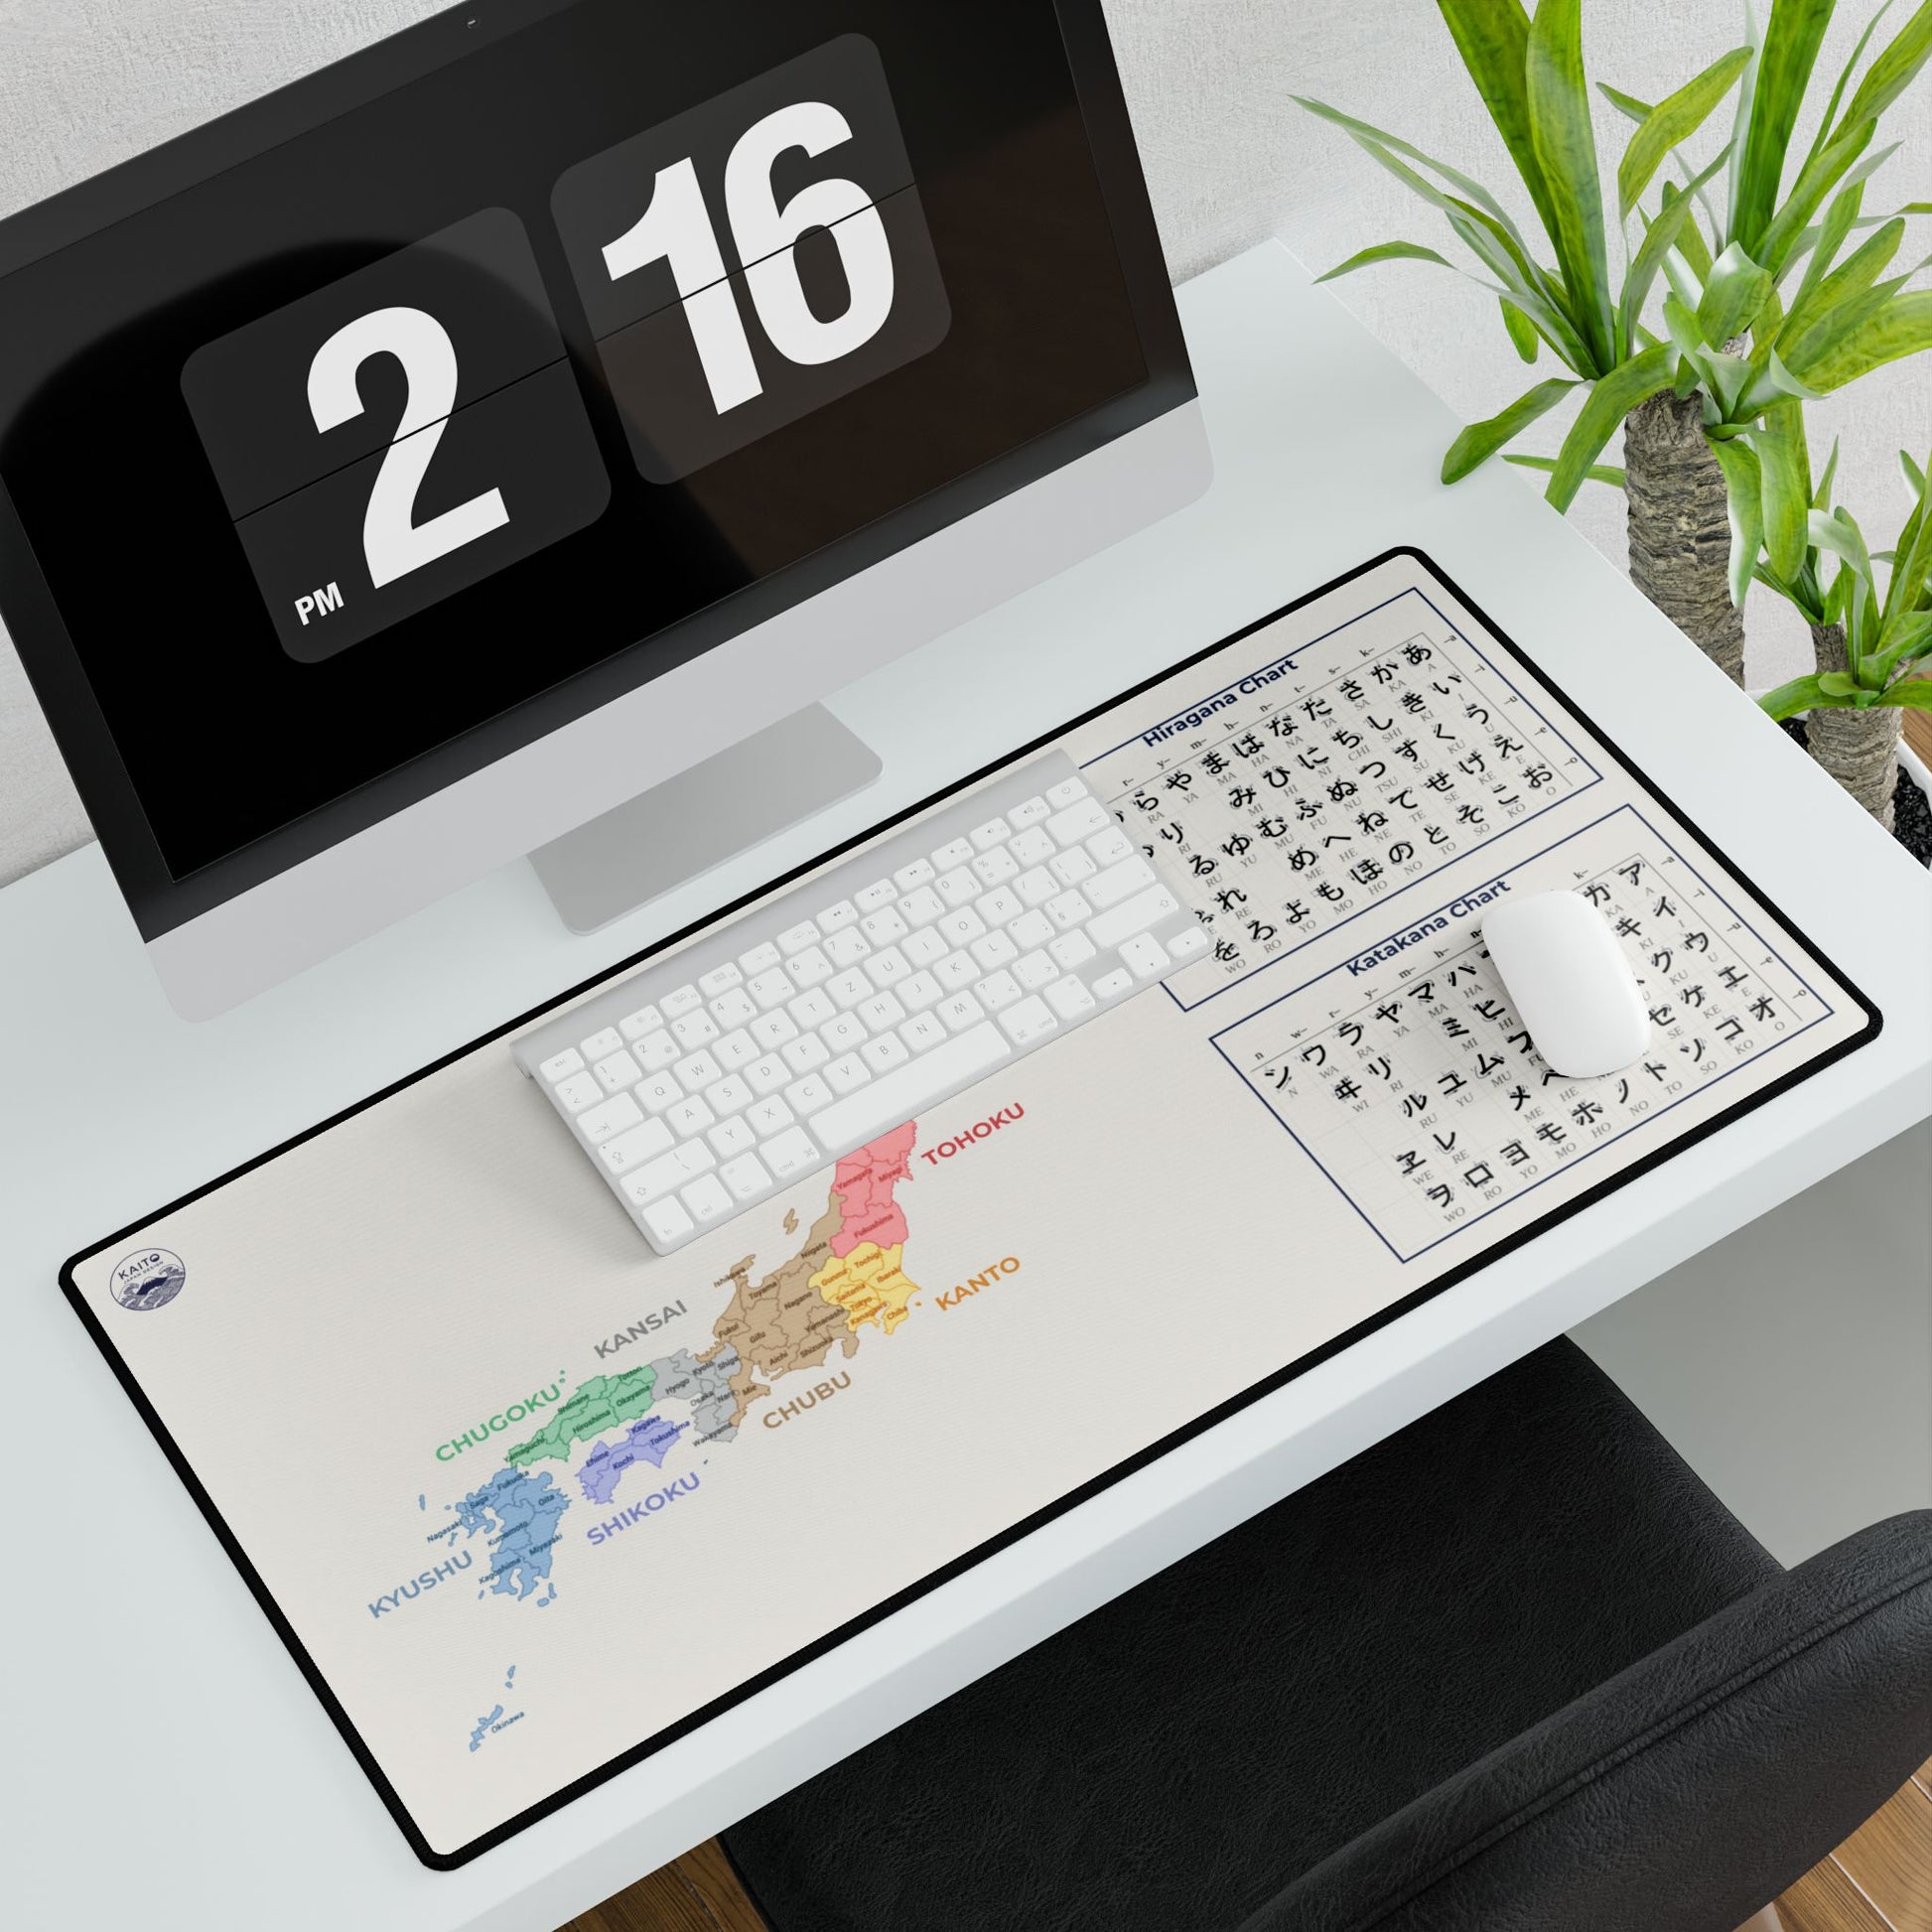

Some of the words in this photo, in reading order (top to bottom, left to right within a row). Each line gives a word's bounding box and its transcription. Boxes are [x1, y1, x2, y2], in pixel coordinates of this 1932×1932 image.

[601, 101, 895, 415] 16
[307, 307, 510, 589] 2
[294, 582, 345, 625] PM
[1401, 644, 1432, 665] あ
[1370, 663, 1399, 685] か
[1339, 680, 1365, 702] さ
[1433, 675, 1461, 695] い
[1142, 692, 1238, 748] Hiragana
[1239, 659, 1299, 695] Chart
[1302, 699, 1333, 722] た
[1401, 693, 1427, 713] き
[1366, 715, 1393, 731] し
[1465, 704, 1489, 725] う
[1268, 717, 1299, 738] な
[1436, 723, 1455, 741] く
[1231, 735, 1265, 759] は
[1331, 730, 1360, 750] ち
[1494, 736, 1524, 759] え
[1297, 747, 1329, 770] に
[1394, 740, 1418, 762] す
[1200, 753, 1230, 774] ま
[1359, 761, 1386, 778] つ
[1458, 753, 1485, 775] け
[1262, 765, 1291, 788] ひ
[1426, 772, 1454, 792] せ
[1523, 765, 1553, 788] お
[1228, 787, 1257, 808] み
[1326, 781, 1359, 802] ぬ
[1388, 789, 1418, 809] て
[1444, 791, 1460, 804] SE
[1493, 785, 1519, 805] こ
[1295, 799, 1323, 821] ふ
[1409, 810, 1427, 824] TE
[1457, 804, 1484, 824] そ
[1507, 803, 1526, 818] KO
[1257, 816, 1288, 838] む
[1357, 812, 1389, 833] ね
[1473, 823, 1491, 837] SO
[1324, 835, 1352, 848] へ
[1424, 826, 1449, 845] と
[1388, 843, 1415, 865] の
[1439, 842, 1457, 856] TO
[1288, 849, 1316, 871] め
[1404, 861, 1423, 876] NO
[1349, 859, 1384, 885] ほ
[1618, 863, 1640, 887] ア
[1317, 884, 1344, 901] も
[1368, 880, 1388, 896] HO
[1585, 886, 1611, 907] カ
[1332, 898, 1354, 914] MO
[1655, 896, 1675, 917] イ
[1346, 916, 1449, 977] Katakana
[1449, 880, 1511, 918] Chart
[1215, 941, 1240, 962] を
[1685, 932, 1709, 953] ウ
[1448, 965, 1477, 987] ハ
[1719, 966, 1748, 989] エ
[1407, 982, 1436, 1004] マ
[1683, 986, 1703, 1008] ケ
[1648, 1007, 1676, 1027] セ
[1749, 998, 1775, 1022] オ
[1442, 1017, 1470, 1038] ミ
[1716, 1019, 1744, 1040] コ
[1302, 1044, 1326, 1066] ワ
[1680, 1038, 1702, 1062] ソ
[1734, 1038, 1754, 1055] KO
[1368, 1056, 1391, 1080] リ
[1476, 1053, 1505, 1076] ム
[1700, 1060, 1718, 1075] SO
[1265, 1066, 1289, 1089] ン
[1664, 1080, 1683, 1095] TO
[1403, 1094, 1428, 1118] ル
[1509, 1085, 1531, 1111] メ
[1629, 1099, 1650, 1116] NO
[1572, 1102, 1603, 1126] ホ
[920, 1102, 1025, 1166] TOHOKU
[1536, 1123, 1567, 1142] モ
[1591, 1121, 1612, 1139] HO
[1433, 1132, 1455, 1151] レ
[1555, 1142, 1577, 1160] MO
[1499, 1142, 1530, 1167] ヨ
[837, 1168, 873, 1190] Yamagata
[1463, 1164, 1494, 1188] ロ
[1519, 1164, 1540, 1180] YO
[1483, 1184, 1502, 1200] RO
[854, 1213, 894, 1239] Fukushima
[118, 1253, 160, 1280] KAITO
[821, 1269, 847, 1286] Gunma
[935, 1256, 1021, 1311] KANTO
[749, 1281, 777, 1301] Toyama
[784, 1291, 812, 1311] Nagano
[850, 1297, 873, 1311] Tokyo
[887, 1306, 907, 1320] Chiba
[594, 1300, 688, 1359] KANSAI
[718, 1322, 740, 1338] Fukui
[750, 1331, 766, 1344] Gifu
[692, 1360, 715, 1377] Kyoto
[717, 1355, 740, 1371] Shiga
[769, 1350, 788, 1366] Aichi
[616, 1385, 650, 1408] Okayama
[665, 1377, 690, 1395] Hyogo
[690, 1390, 715, 1407] Osaka
[717, 1391, 736, 1403] Nara
[762, 1371, 851, 1429] CHUBU
[435, 1383, 561, 1461] CHUGOKU
[573, 1409, 611, 1435] Hiroshima
[649, 1420, 690, 1447] Tokushima
[692, 1422, 733, 1448] Wakayama
[613, 1453, 634, 1469] Kochi
[470, 1495, 488, 1509] Saga
[538, 1493, 555, 1506] Oita
[587, 1471, 700, 1546] SHIKOKU
[427, 1519, 463, 1543] Nagasaki
[479, 1557, 521, 1585] Kagoshima
[367, 1550, 473, 1618] KYUSHU
[491, 1712, 524, 1733] Okinawa
